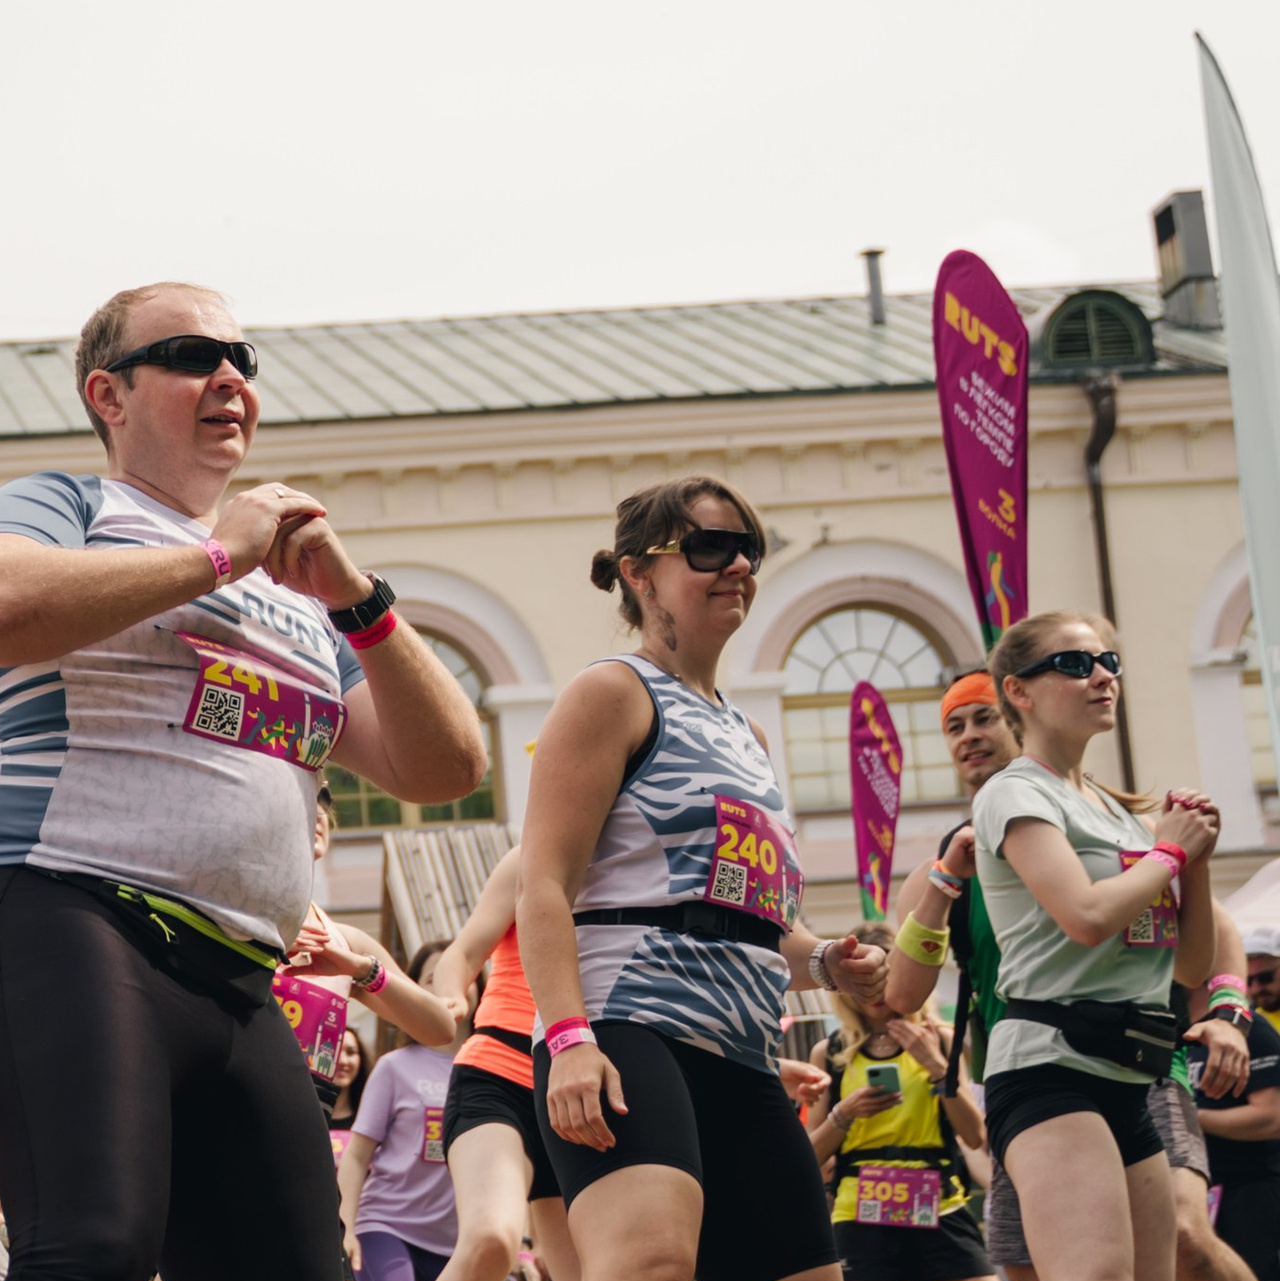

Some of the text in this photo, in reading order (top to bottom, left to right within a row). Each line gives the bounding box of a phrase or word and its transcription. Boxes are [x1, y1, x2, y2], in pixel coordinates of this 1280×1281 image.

[944, 291, 1018, 377] RUTS
[998, 487, 1017, 524] 3
[243, 590, 325, 653] RUN
[203, 656, 280, 702] 241
[720, 801, 747, 818] RUTS
[717, 823, 778, 875] 240
[860, 1180, 910, 1204] 305
